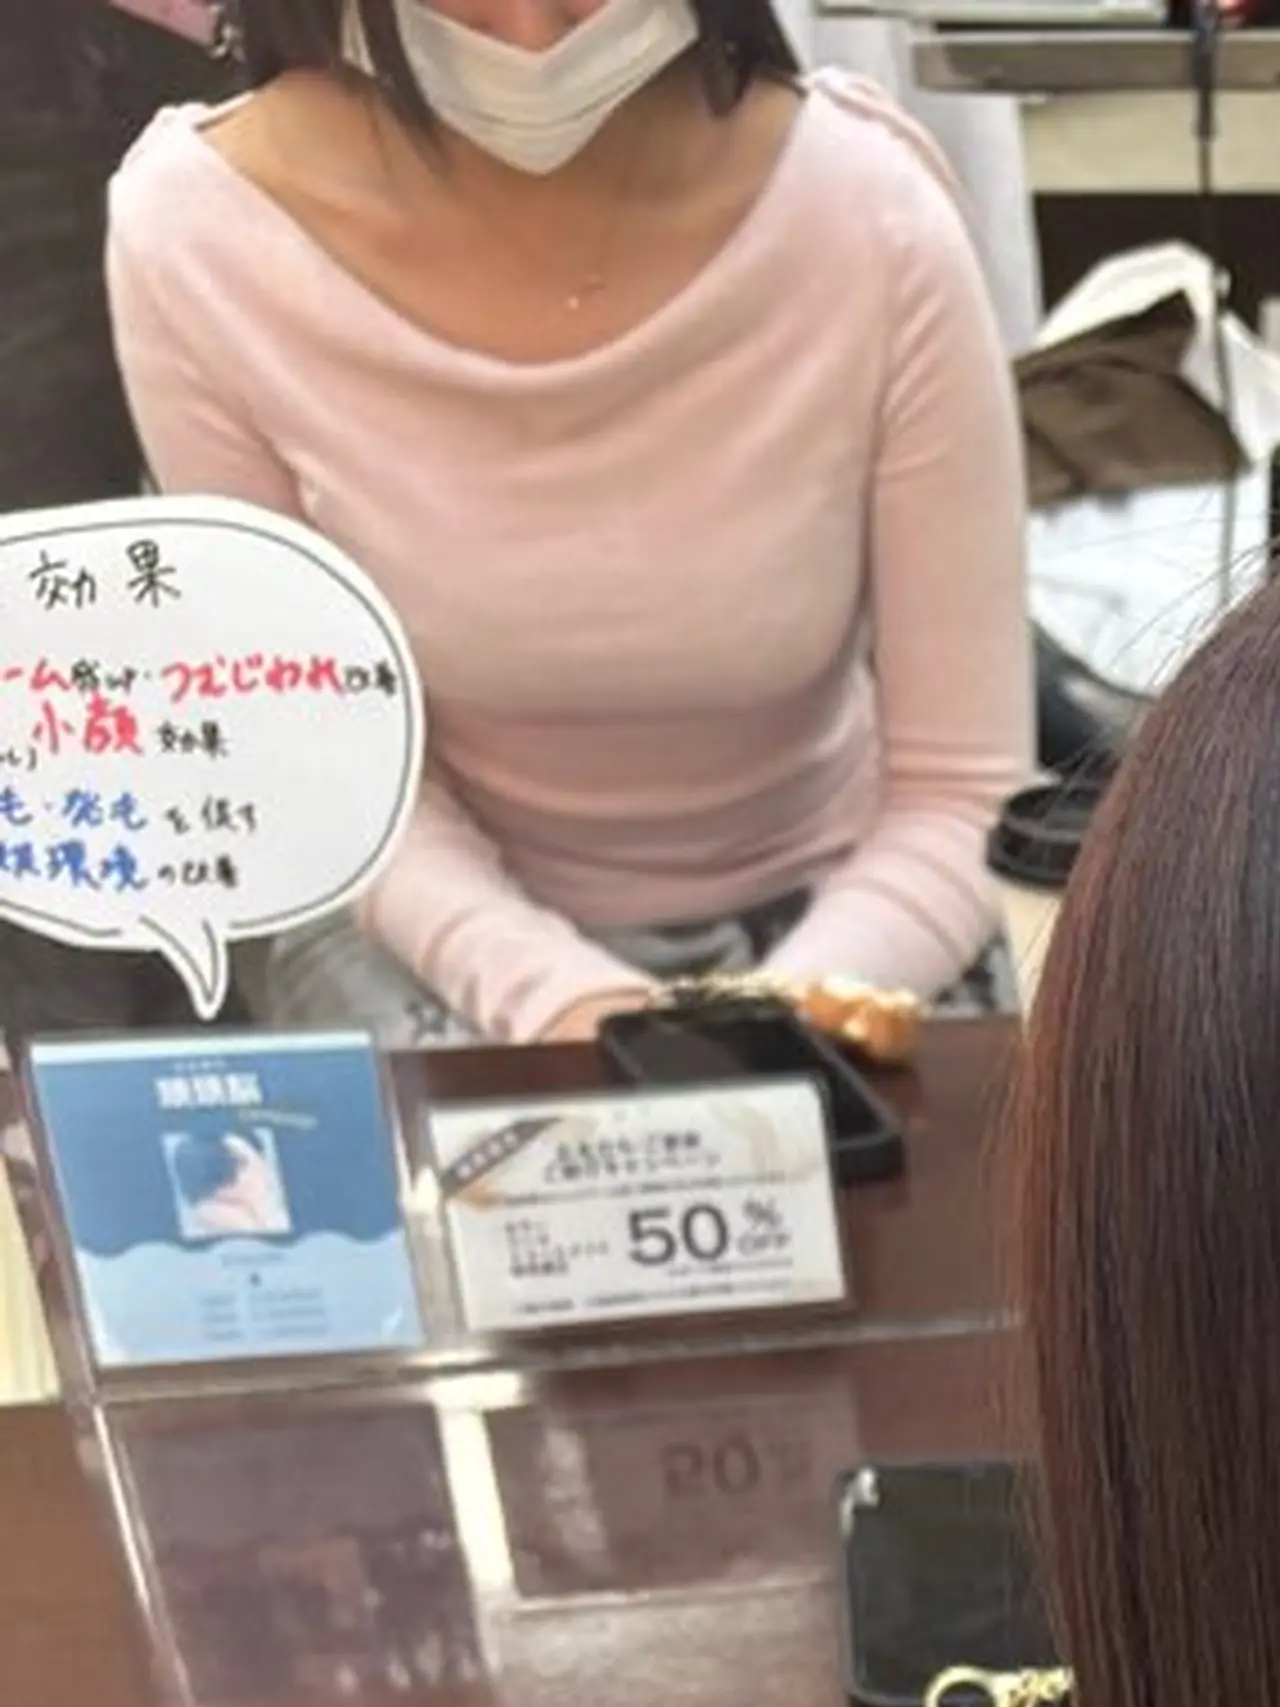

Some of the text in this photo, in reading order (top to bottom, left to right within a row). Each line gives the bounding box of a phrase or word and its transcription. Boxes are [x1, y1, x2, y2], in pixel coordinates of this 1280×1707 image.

[628, 1203, 729, 1266] 50
[741, 1198, 783, 1231] %
[736, 1232, 792, 1257] OFF
